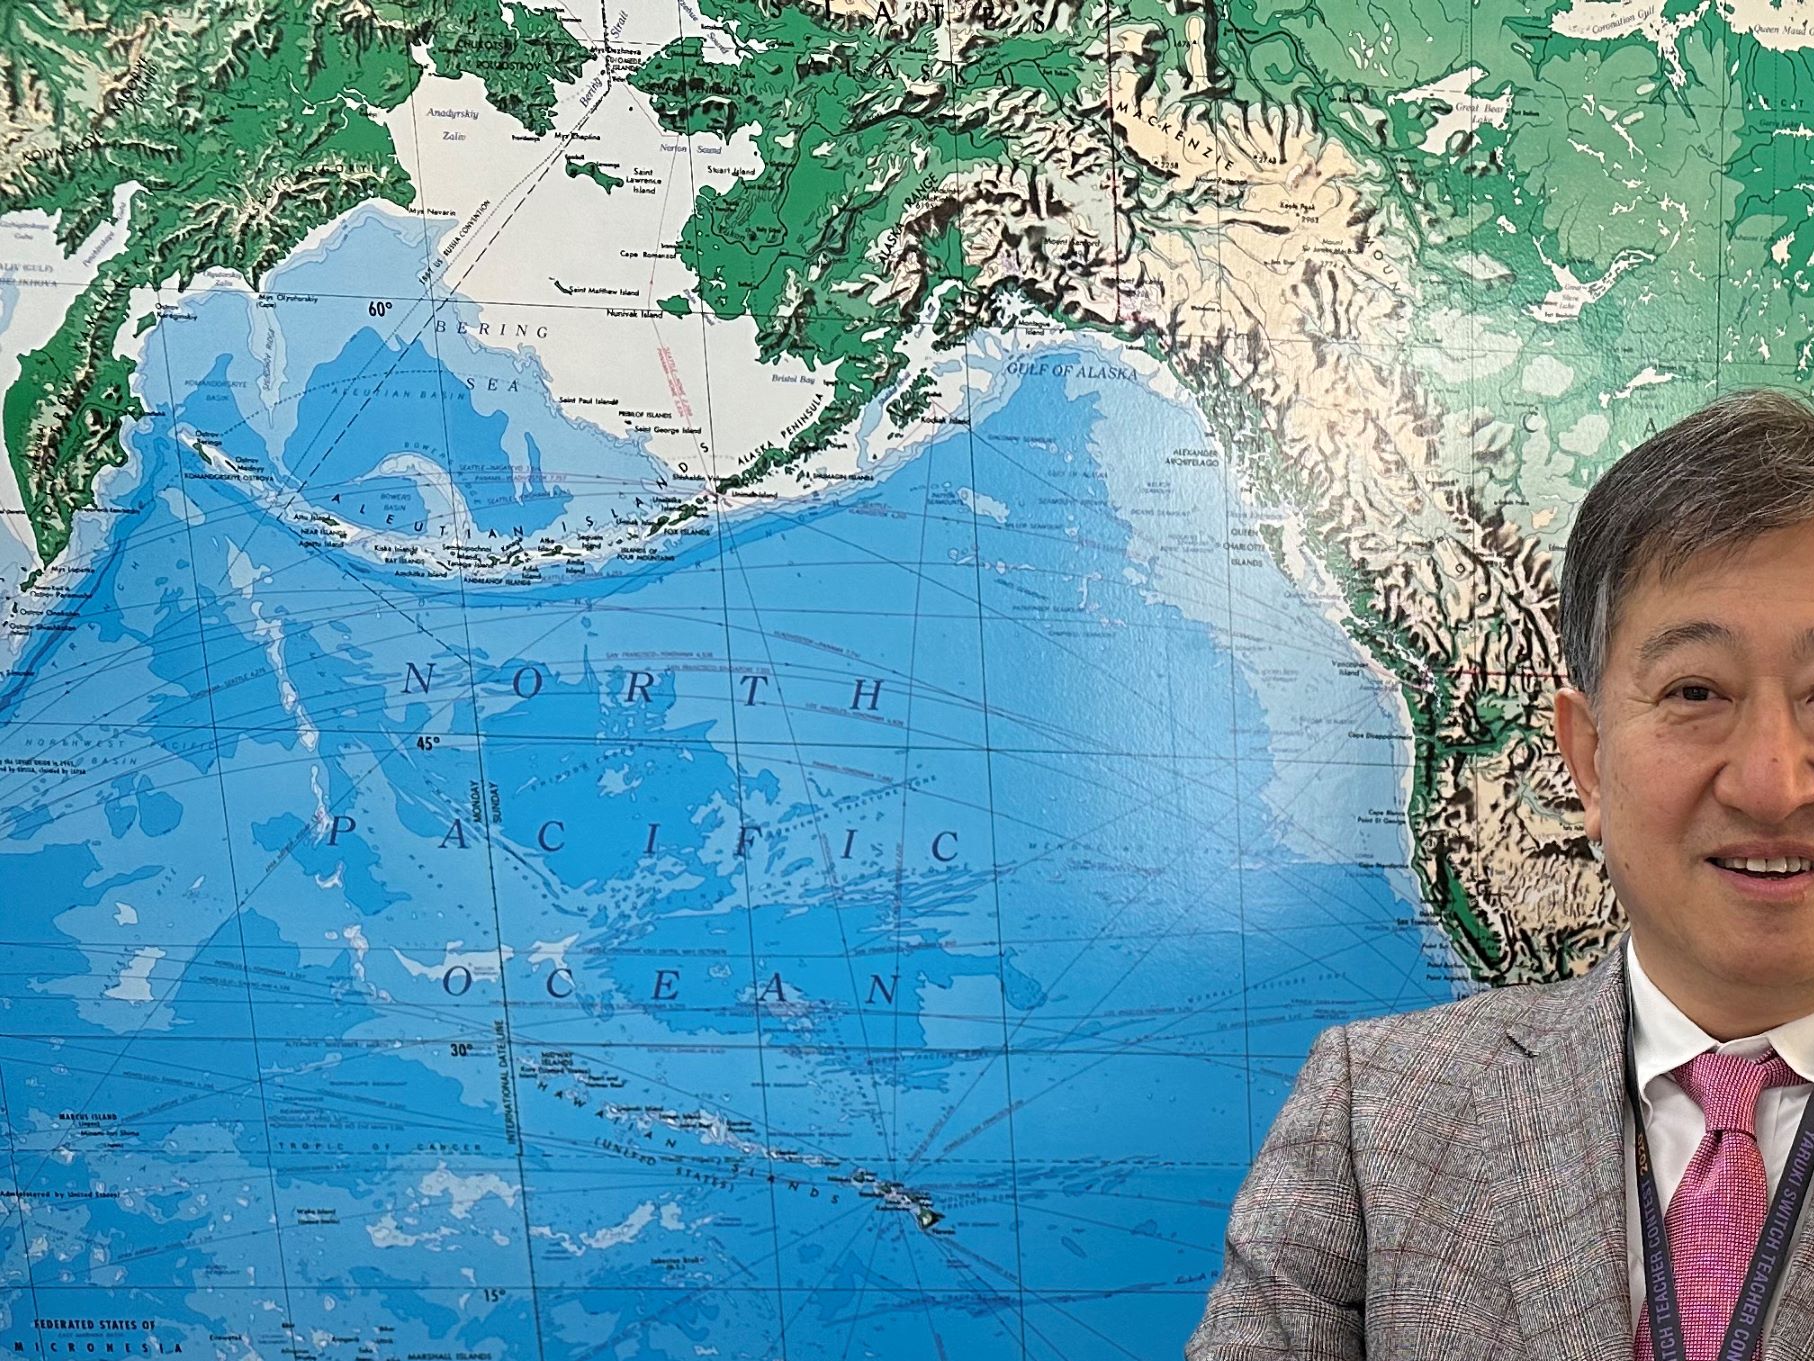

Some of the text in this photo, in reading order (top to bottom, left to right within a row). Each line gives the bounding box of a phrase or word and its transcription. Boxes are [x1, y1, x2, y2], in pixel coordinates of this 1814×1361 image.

[1592, 7, 1655, 34] Coronation Gulf
[1754, 24, 1779, 34] Queen
[1784, 25, 1807, 35] Maud
[626, 177, 661, 185] Lawrence
[634, 168, 653, 176] Saint
[633, 186, 656, 194] Island
[368, 301, 393, 317] 60°
[607, 309, 663, 319] Nunivak Island
[435, 320, 548, 339] BERING
[1006, 362, 1138, 381] GULF OF ALASKA
[465, 377, 519, 392] SEA
[653, 427, 680, 435] George
[738, 393, 823, 466] ALASKA PENINSULA
[401, 661, 886, 712] NORTH
[417, 736, 441, 752] 45°
[473, 780, 482, 824] MONDAY
[490, 782, 500, 824] SUNDAY
[326, 815, 959, 863] PACIFIC
[442, 965, 901, 1005] OCEAN
[451, 1043, 472, 1057] 30°
[495, 1020, 515, 1145] INTERNATIONAL DATE LINE
[1637, 1132, 1648, 1175] 2020
[1640, 1180, 1662, 1249] CONTEST
[1768, 1186, 1798, 1250] SWITCH
[484, 1289, 506, 1302] 15°
[1652, 1250, 1671, 1322] TEACHER
[1739, 1253, 1777, 1325] TEACHER
[34, 1320, 156, 1331] FEDERATED STATES OF
[14, 1342, 182, 1353] MICRONESIA
[408, 1353, 492, 1361] MARSHALL ISLANDS
